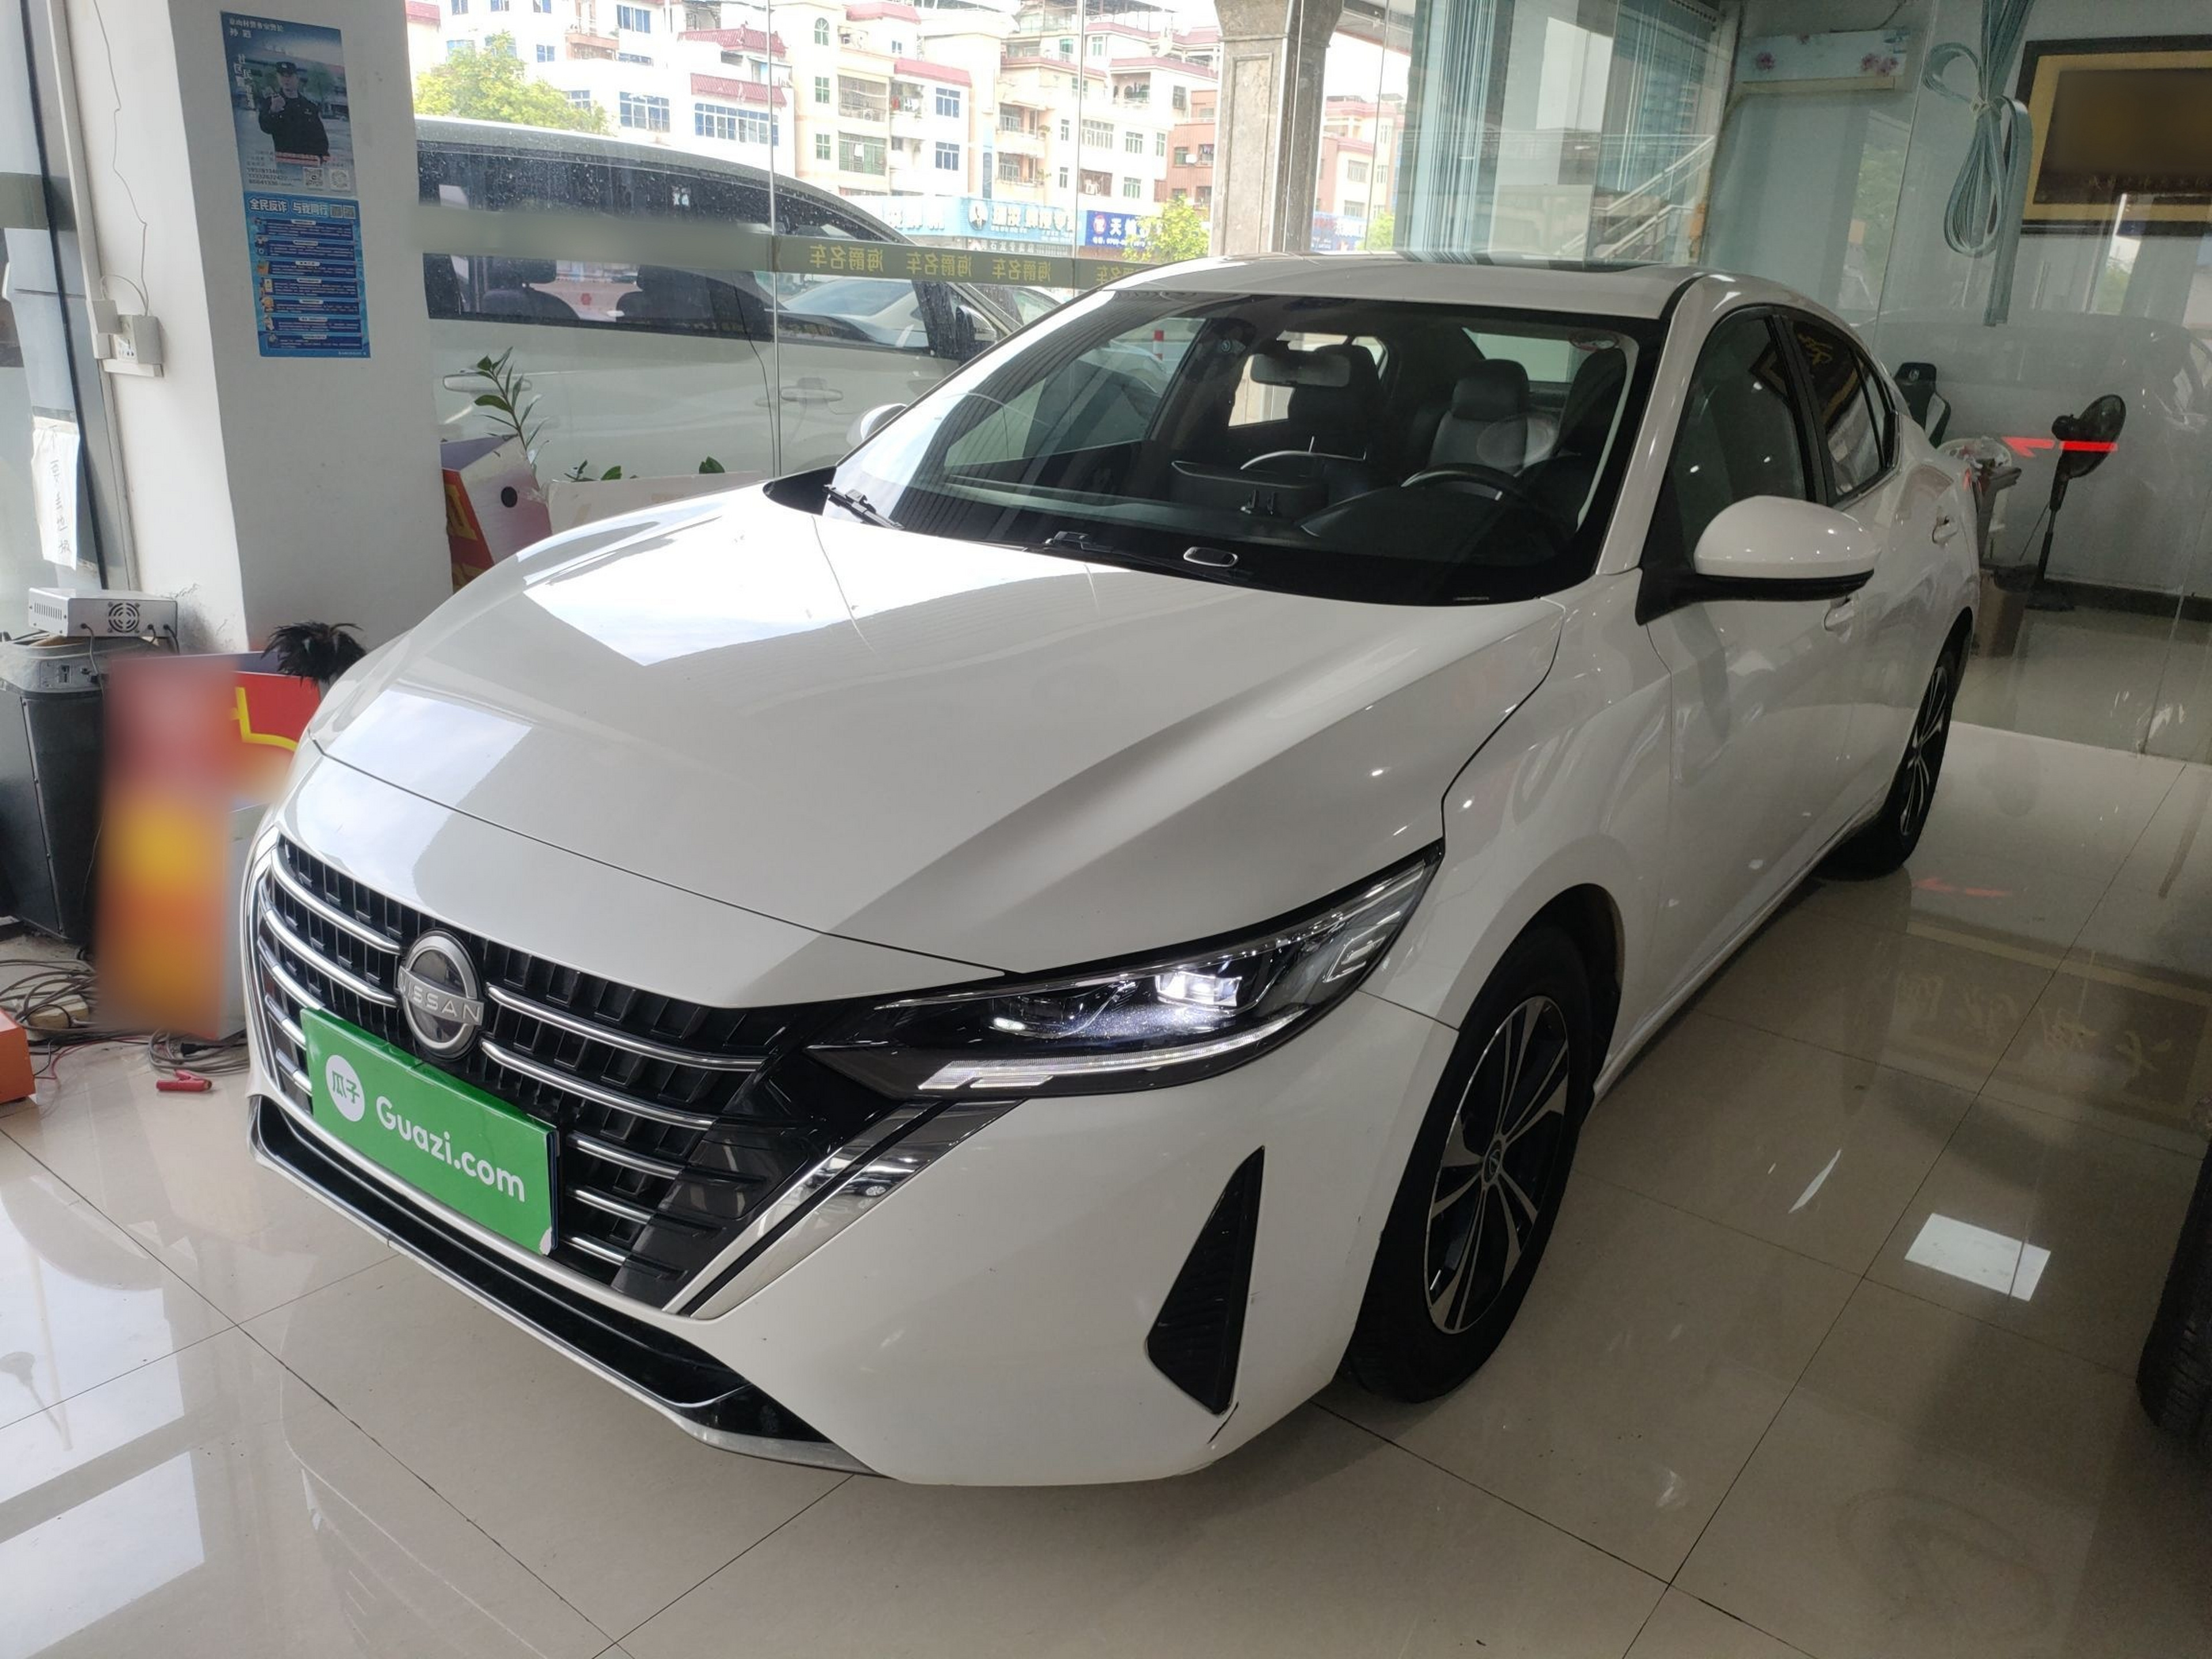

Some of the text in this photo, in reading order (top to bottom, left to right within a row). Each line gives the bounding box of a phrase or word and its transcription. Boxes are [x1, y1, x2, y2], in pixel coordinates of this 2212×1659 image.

[249, 198, 328, 216] 全民反诈 与我同行
[399, 971, 481, 1023] NISSAN
[332, 1070, 361, 1104] 瓜子
[376, 1095, 525, 1203] Guazi.com
